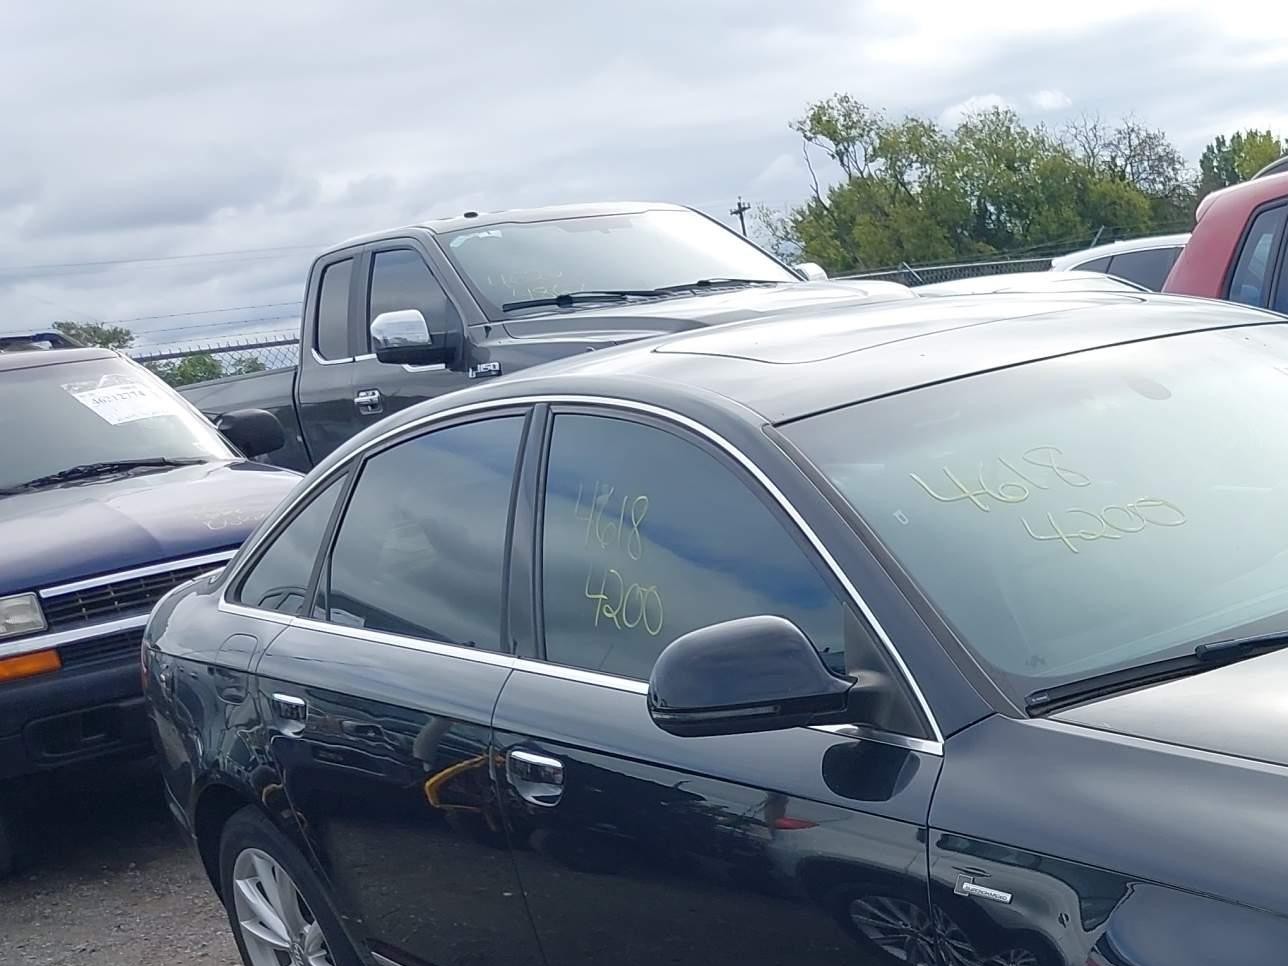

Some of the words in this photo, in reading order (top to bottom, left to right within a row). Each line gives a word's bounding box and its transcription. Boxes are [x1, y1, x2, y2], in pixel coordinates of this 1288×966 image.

[909, 444, 1091, 512] 4618
[574, 479, 650, 561] 4618
[1020, 496, 1188, 554] 4200
[585, 561, 664, 636] 4200
